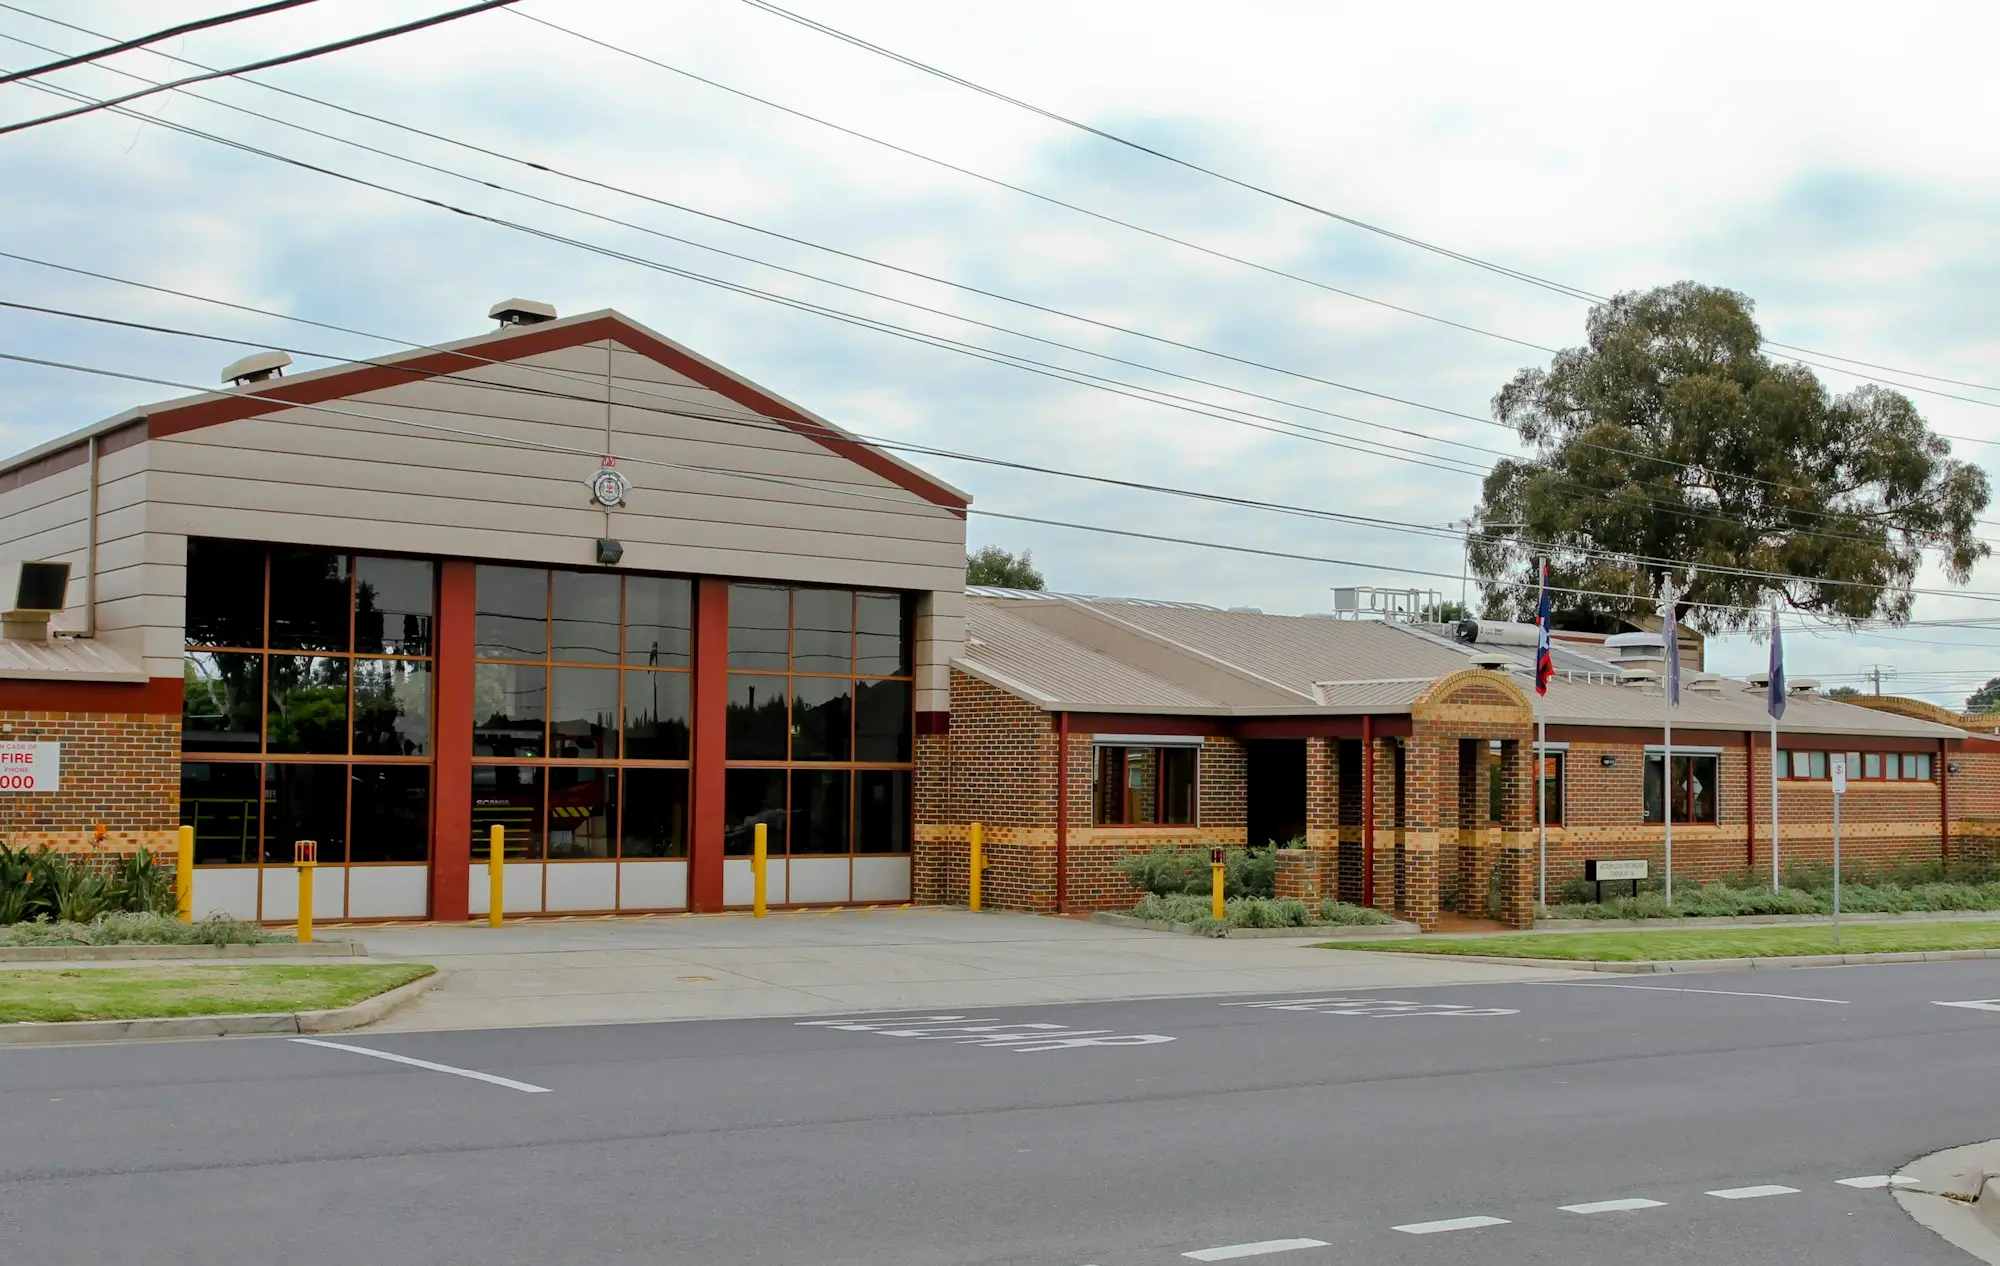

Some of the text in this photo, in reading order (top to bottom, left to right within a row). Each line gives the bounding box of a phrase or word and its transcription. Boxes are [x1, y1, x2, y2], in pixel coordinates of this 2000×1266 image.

[1, 753, 33, 763] FIRE
[0, 775, 34, 789] 000
[1218, 997, 1521, 1018] KEEP
[793, 1015, 1179, 1053] CLEAR
